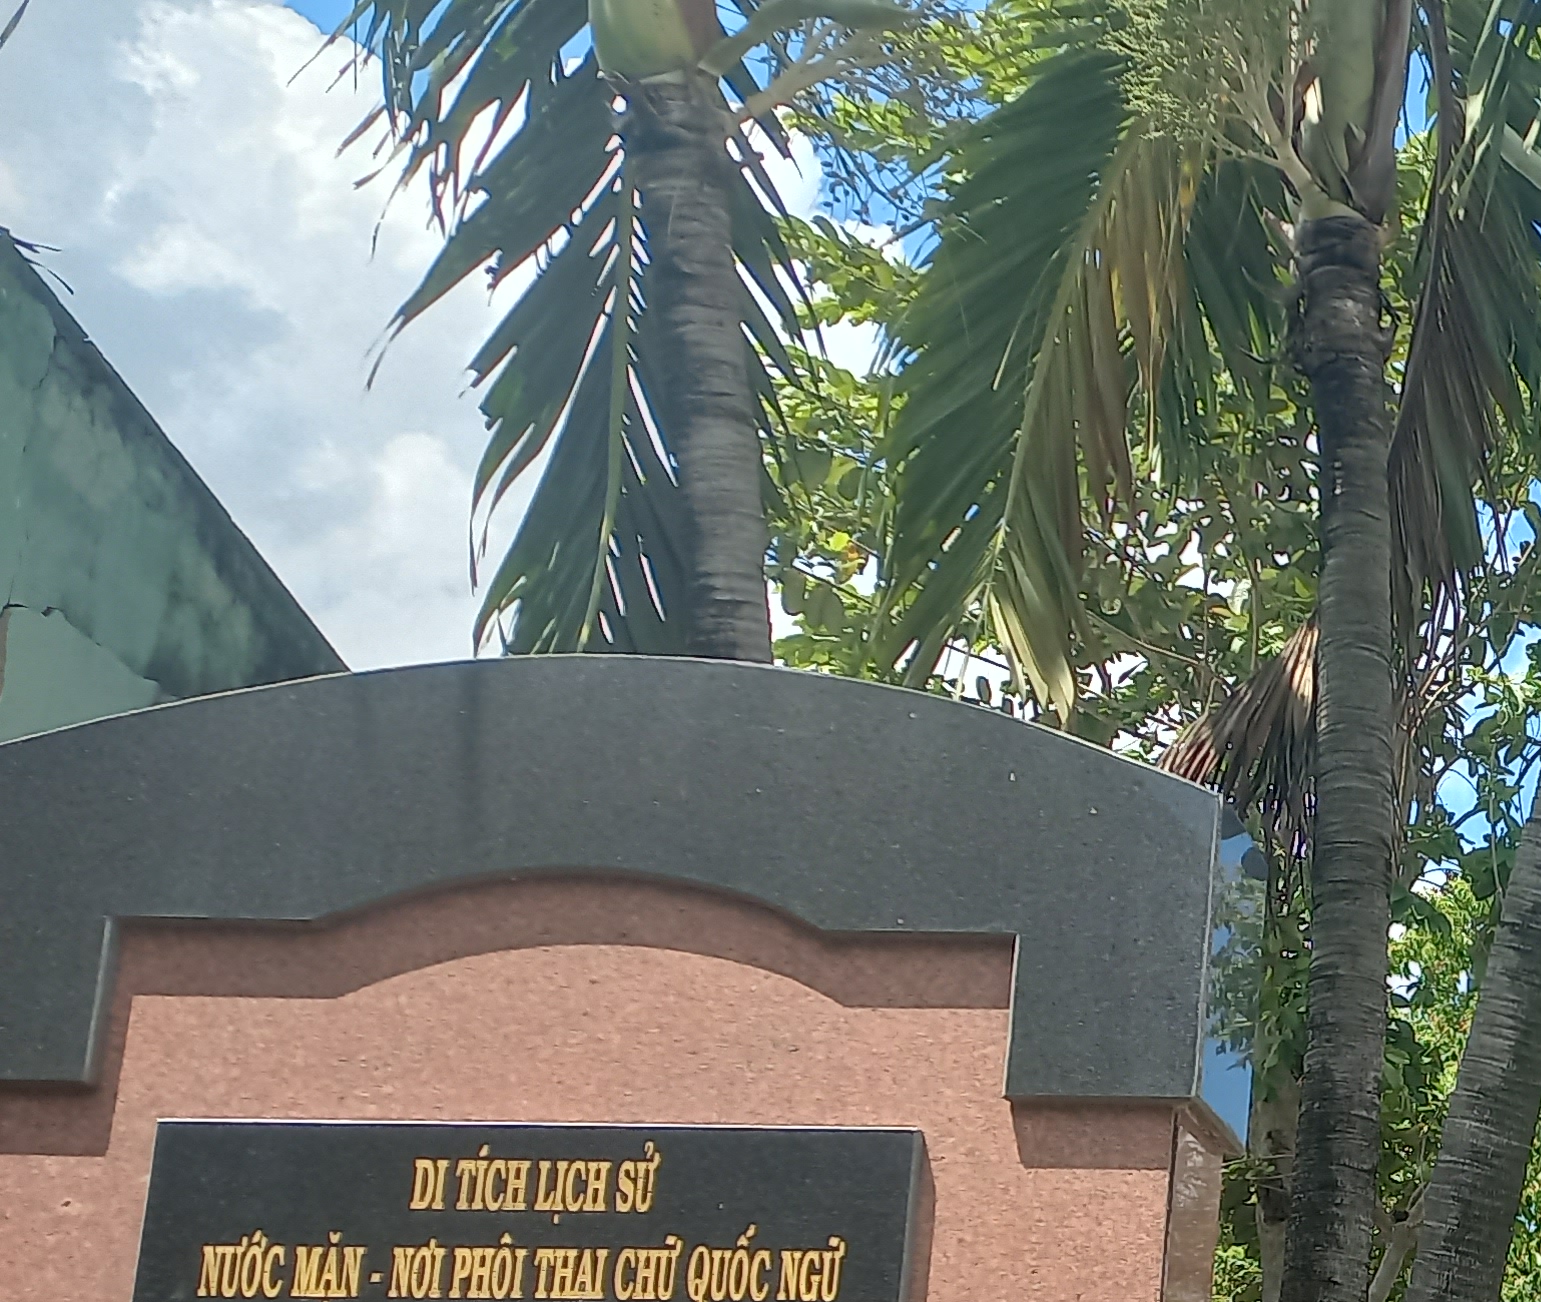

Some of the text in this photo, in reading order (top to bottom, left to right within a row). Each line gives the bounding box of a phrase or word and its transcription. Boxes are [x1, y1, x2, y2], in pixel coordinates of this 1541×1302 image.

[408, 1141, 662, 1222] DI TÍCH LỊCH SỬ
[196, 1229, 286, 1298] NƯỚC
[386, 1237, 448, 1299] NƠI
[447, 1232, 530, 1300] PHÔI
[532, 1247, 610, 1300] THAI
[612, 1234, 683, 1301] CHỮ
[775, 1236, 846, 1302] NGỮ
